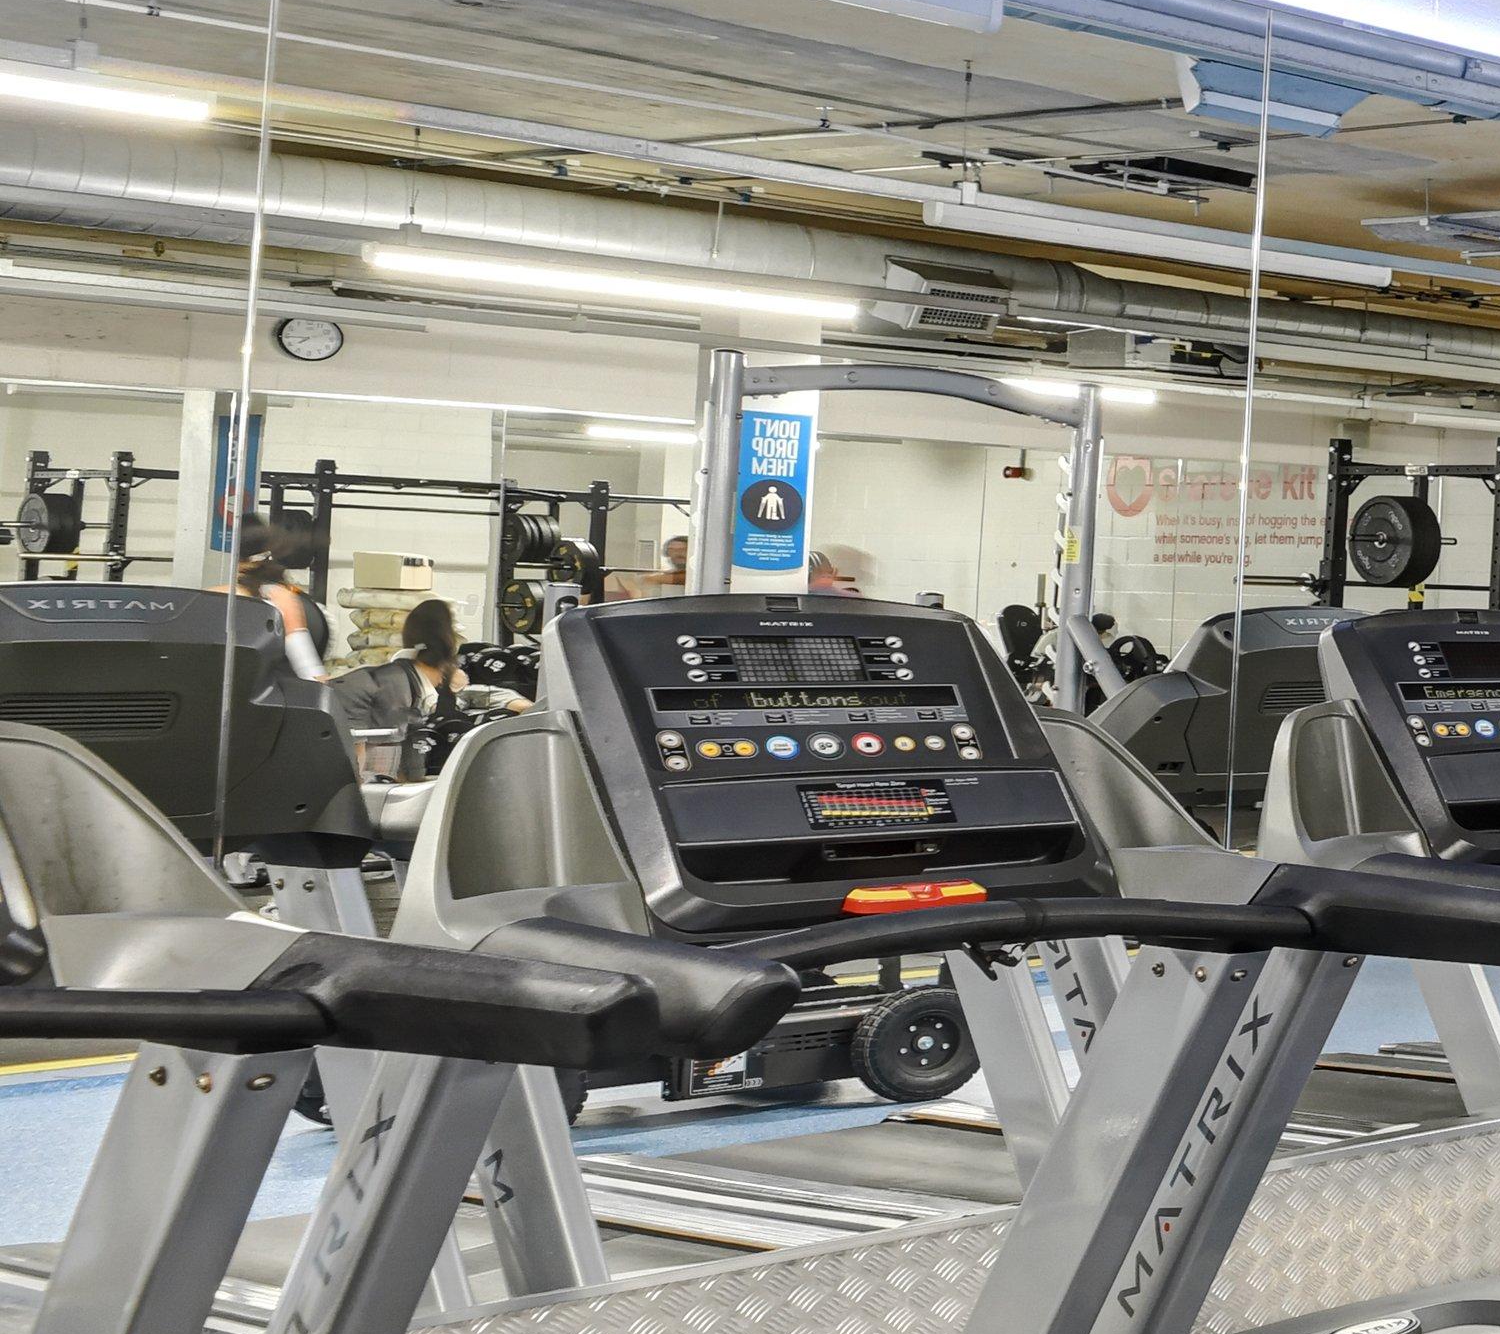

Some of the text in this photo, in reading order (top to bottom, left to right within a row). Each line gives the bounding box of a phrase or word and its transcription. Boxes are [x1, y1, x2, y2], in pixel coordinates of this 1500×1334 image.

[1156, 513, 1180, 526] Whe
[1257, 516, 1298, 530] hogging
[1300, 515, 1318, 527] the
[1180, 533, 1231, 546] someone's
[1269, 533, 1295, 546] them
[1297, 534, 1323, 549] jump
[1117, 992, 1274, 1320] MATRIX
